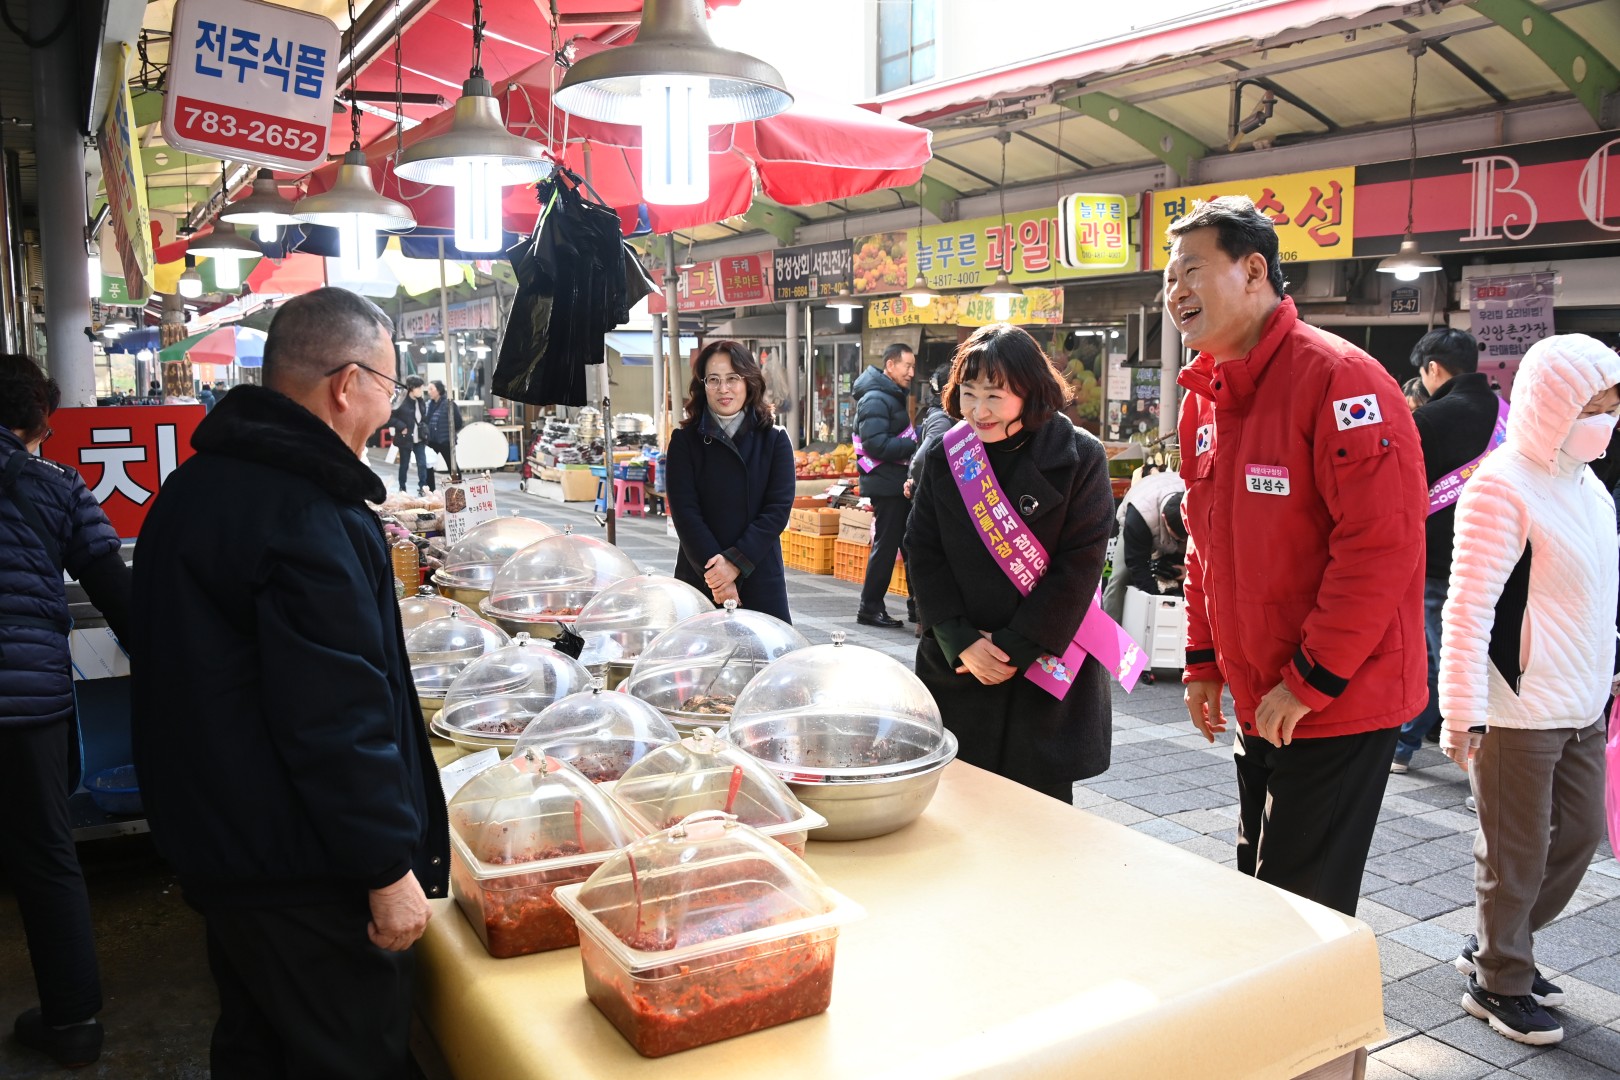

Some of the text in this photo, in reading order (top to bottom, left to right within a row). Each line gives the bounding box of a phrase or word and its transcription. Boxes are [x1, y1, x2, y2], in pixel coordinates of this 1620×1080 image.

[195, 20, 327, 99] 전주식품
[184, 106, 318, 154] 783-2652
[1080, 202, 1121, 219] 늘푸른
[915, 217, 1060, 273] 늘푸른 과일
[1080, 222, 1122, 248] 과일
[732, 258, 750, 274] 두레
[775, 247, 851, 281] 명성상회 서진전자
[725, 275, 760, 289] 그릇마트
[1393, 299, 1417, 312] 95-47
[1480, 307, 1543, 320] 우리집 요리비법!
[1489, 342, 1532, 356] 판매합니
[954, 443, 982, 471] 2025
[469, 484, 489, 498] 번데기
[1251, 477, 1286, 493] 김성수
[980, 474, 1019, 534] 시장에서
[972, 500, 1014, 559] 전통시장
